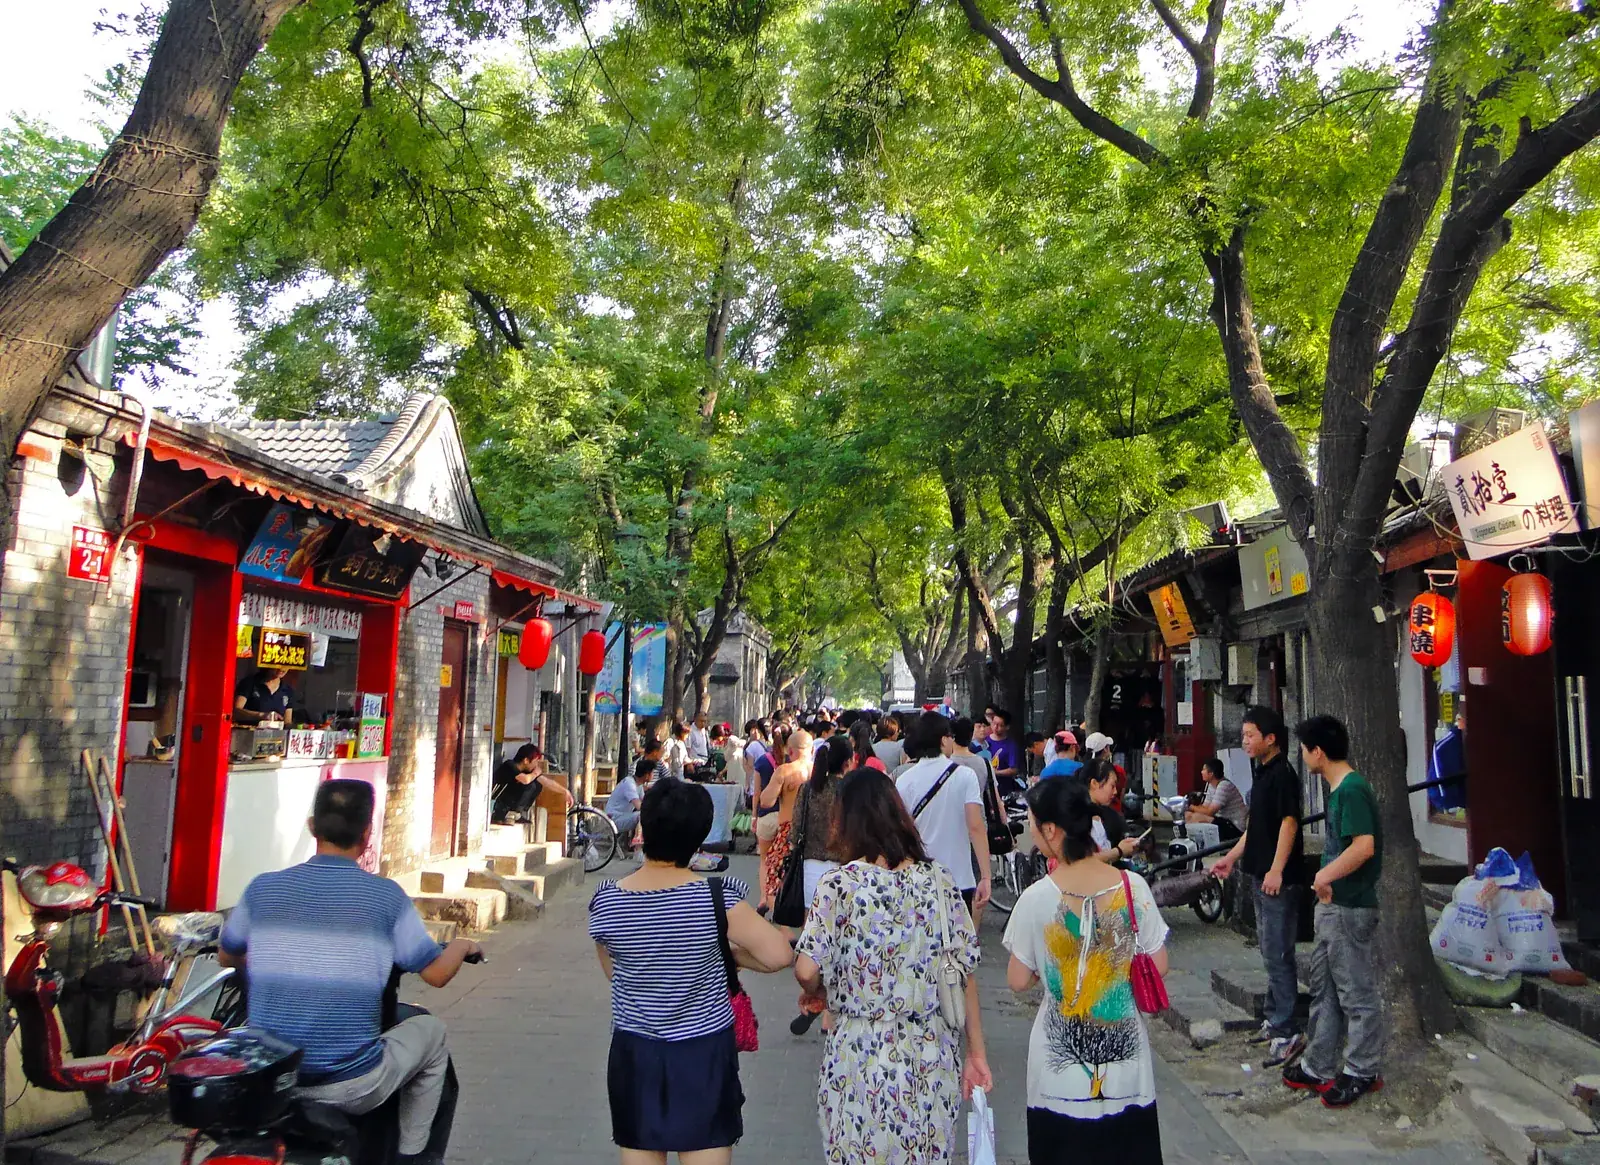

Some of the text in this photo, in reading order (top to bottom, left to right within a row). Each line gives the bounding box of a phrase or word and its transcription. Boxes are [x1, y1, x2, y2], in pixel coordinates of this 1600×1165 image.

[1522, 494, 1568, 531] の料理
[81, 549, 102, 574] 2-1
[1112, 684, 1122, 699] 2
